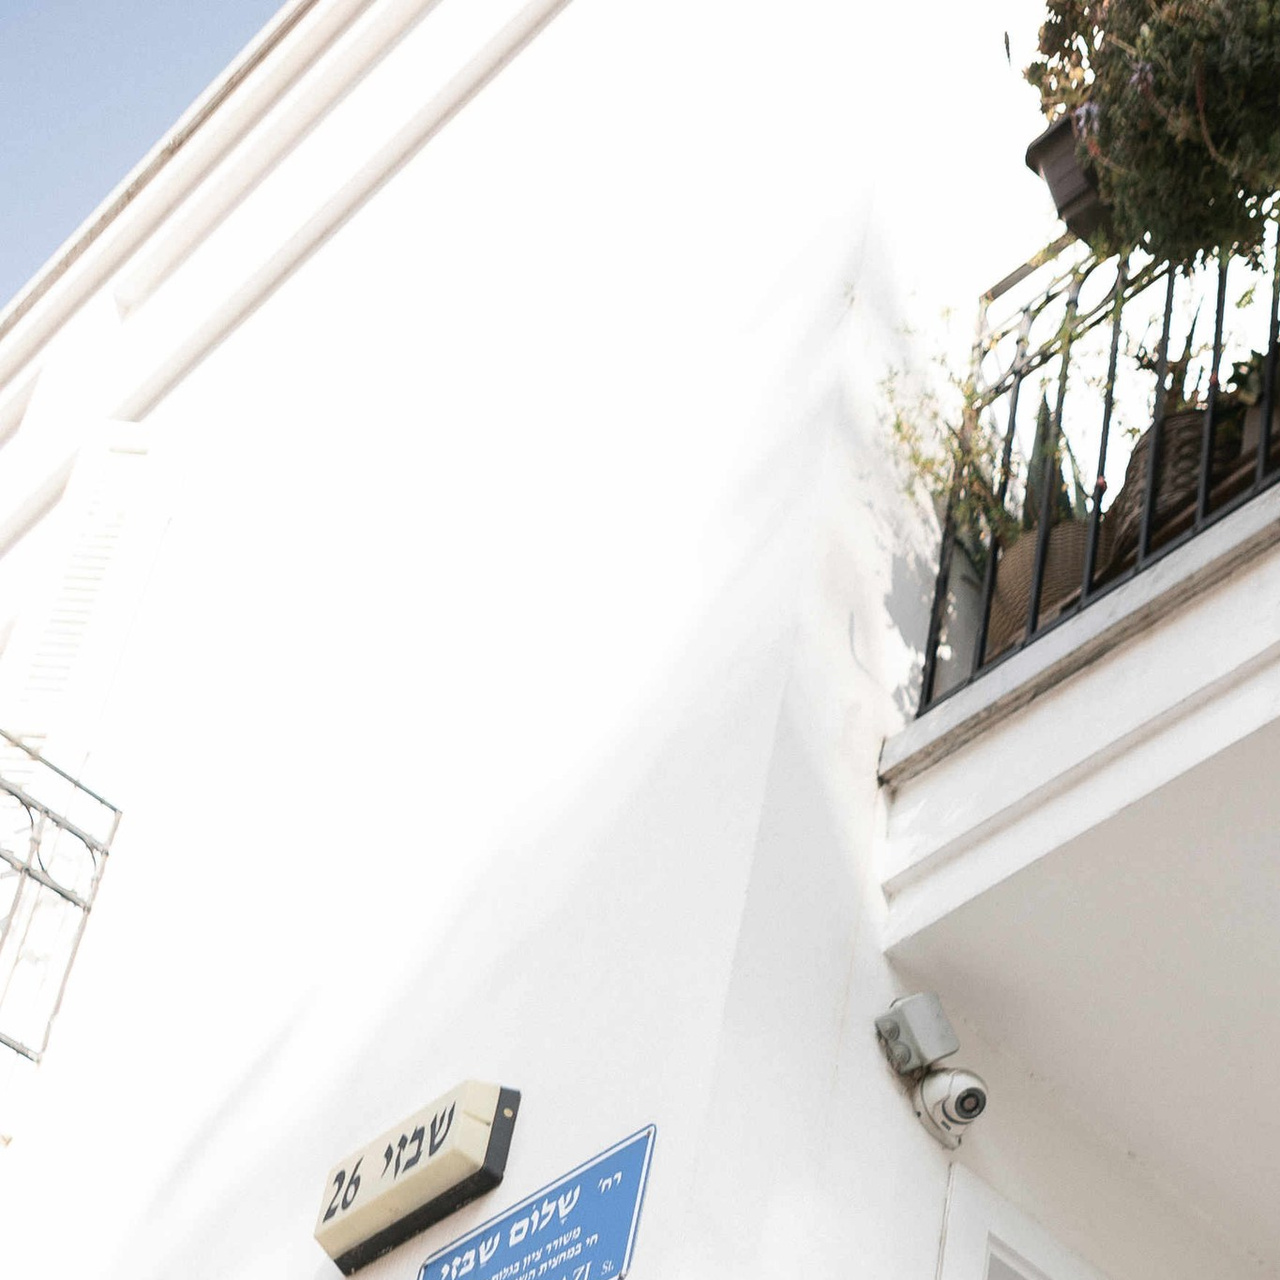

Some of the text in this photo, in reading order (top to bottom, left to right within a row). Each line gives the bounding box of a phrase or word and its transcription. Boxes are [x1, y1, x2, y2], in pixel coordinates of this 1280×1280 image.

[323, 1101, 456, 1222] שבזי 26
[545, 1226, 581, 1254] משורר
[585, 1233, 599, 1247] חי
[522, 1247, 543, 1271] ציון
[538, 1242, 582, 1276] במחצית
[601, 1260, 614, 1275] St.
